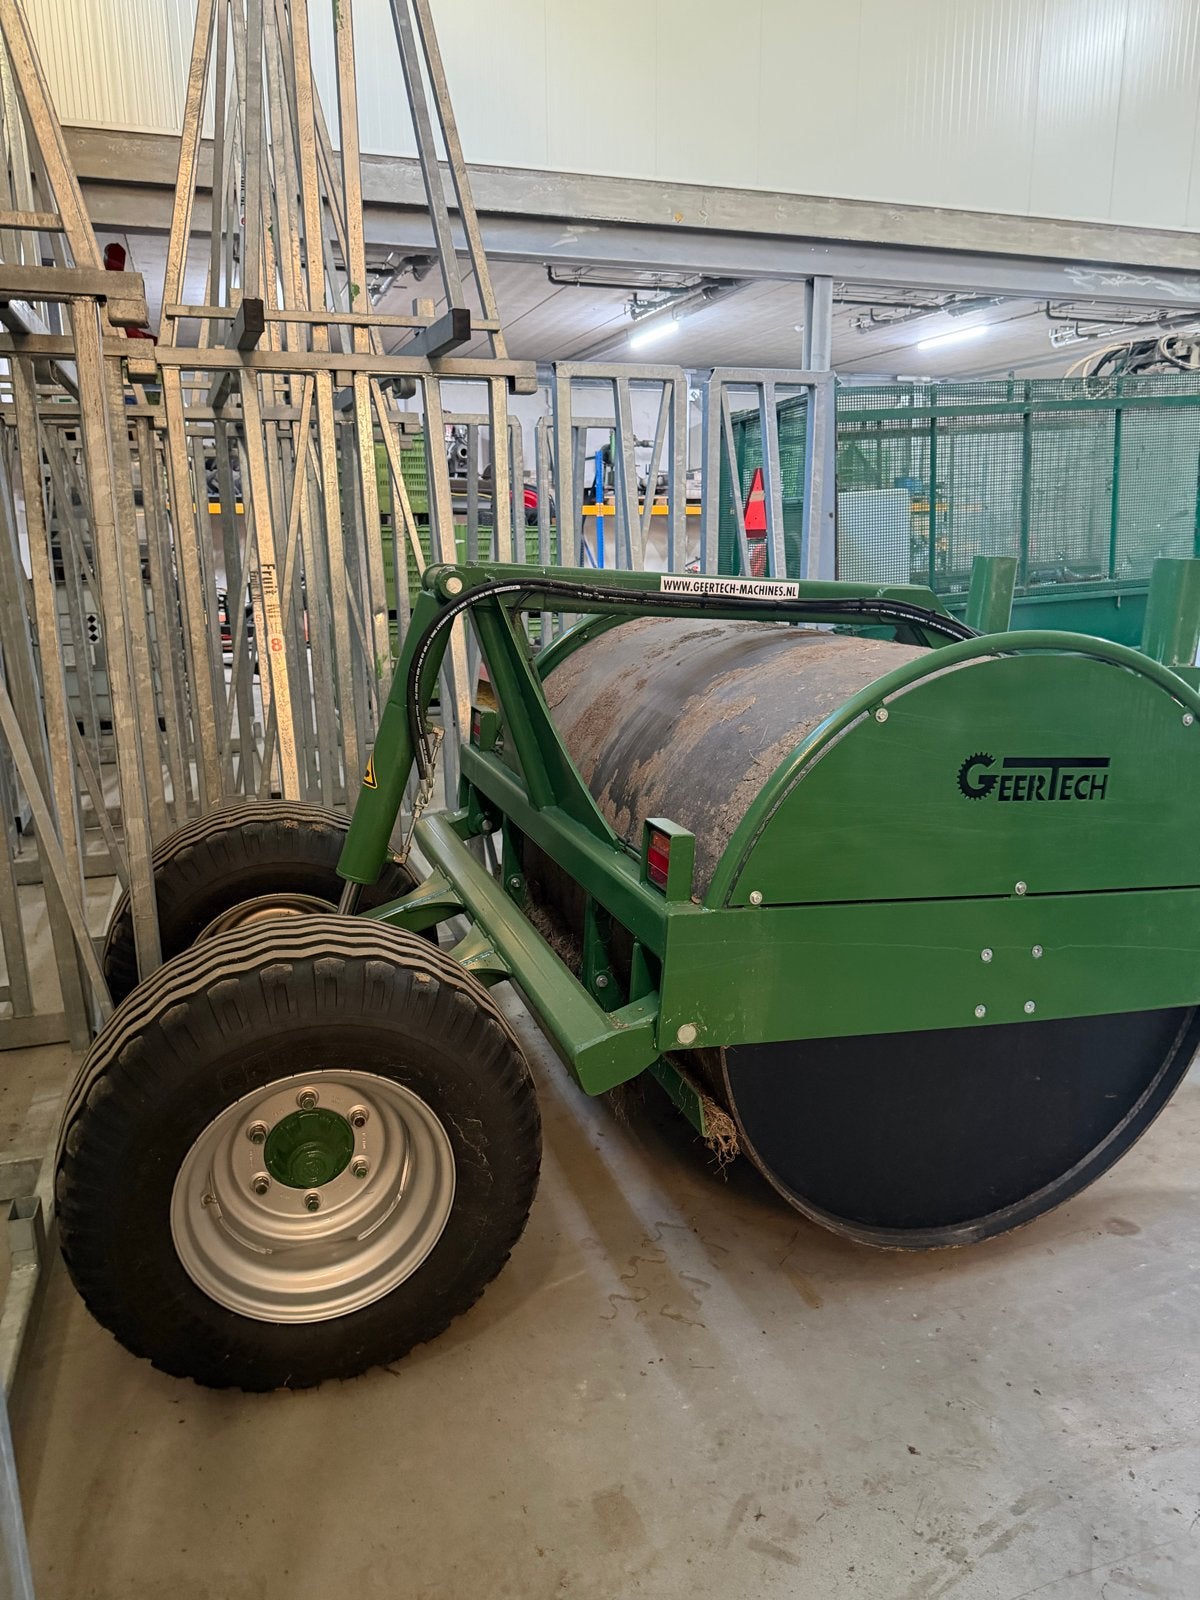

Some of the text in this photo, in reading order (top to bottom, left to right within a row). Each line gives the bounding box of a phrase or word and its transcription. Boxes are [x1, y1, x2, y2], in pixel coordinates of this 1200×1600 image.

[262, 564, 278, 595] Fruit
[271, 638, 283, 652] 8
[663, 580, 797, 597] WWW.GEERTECH-MACHINES.NL
